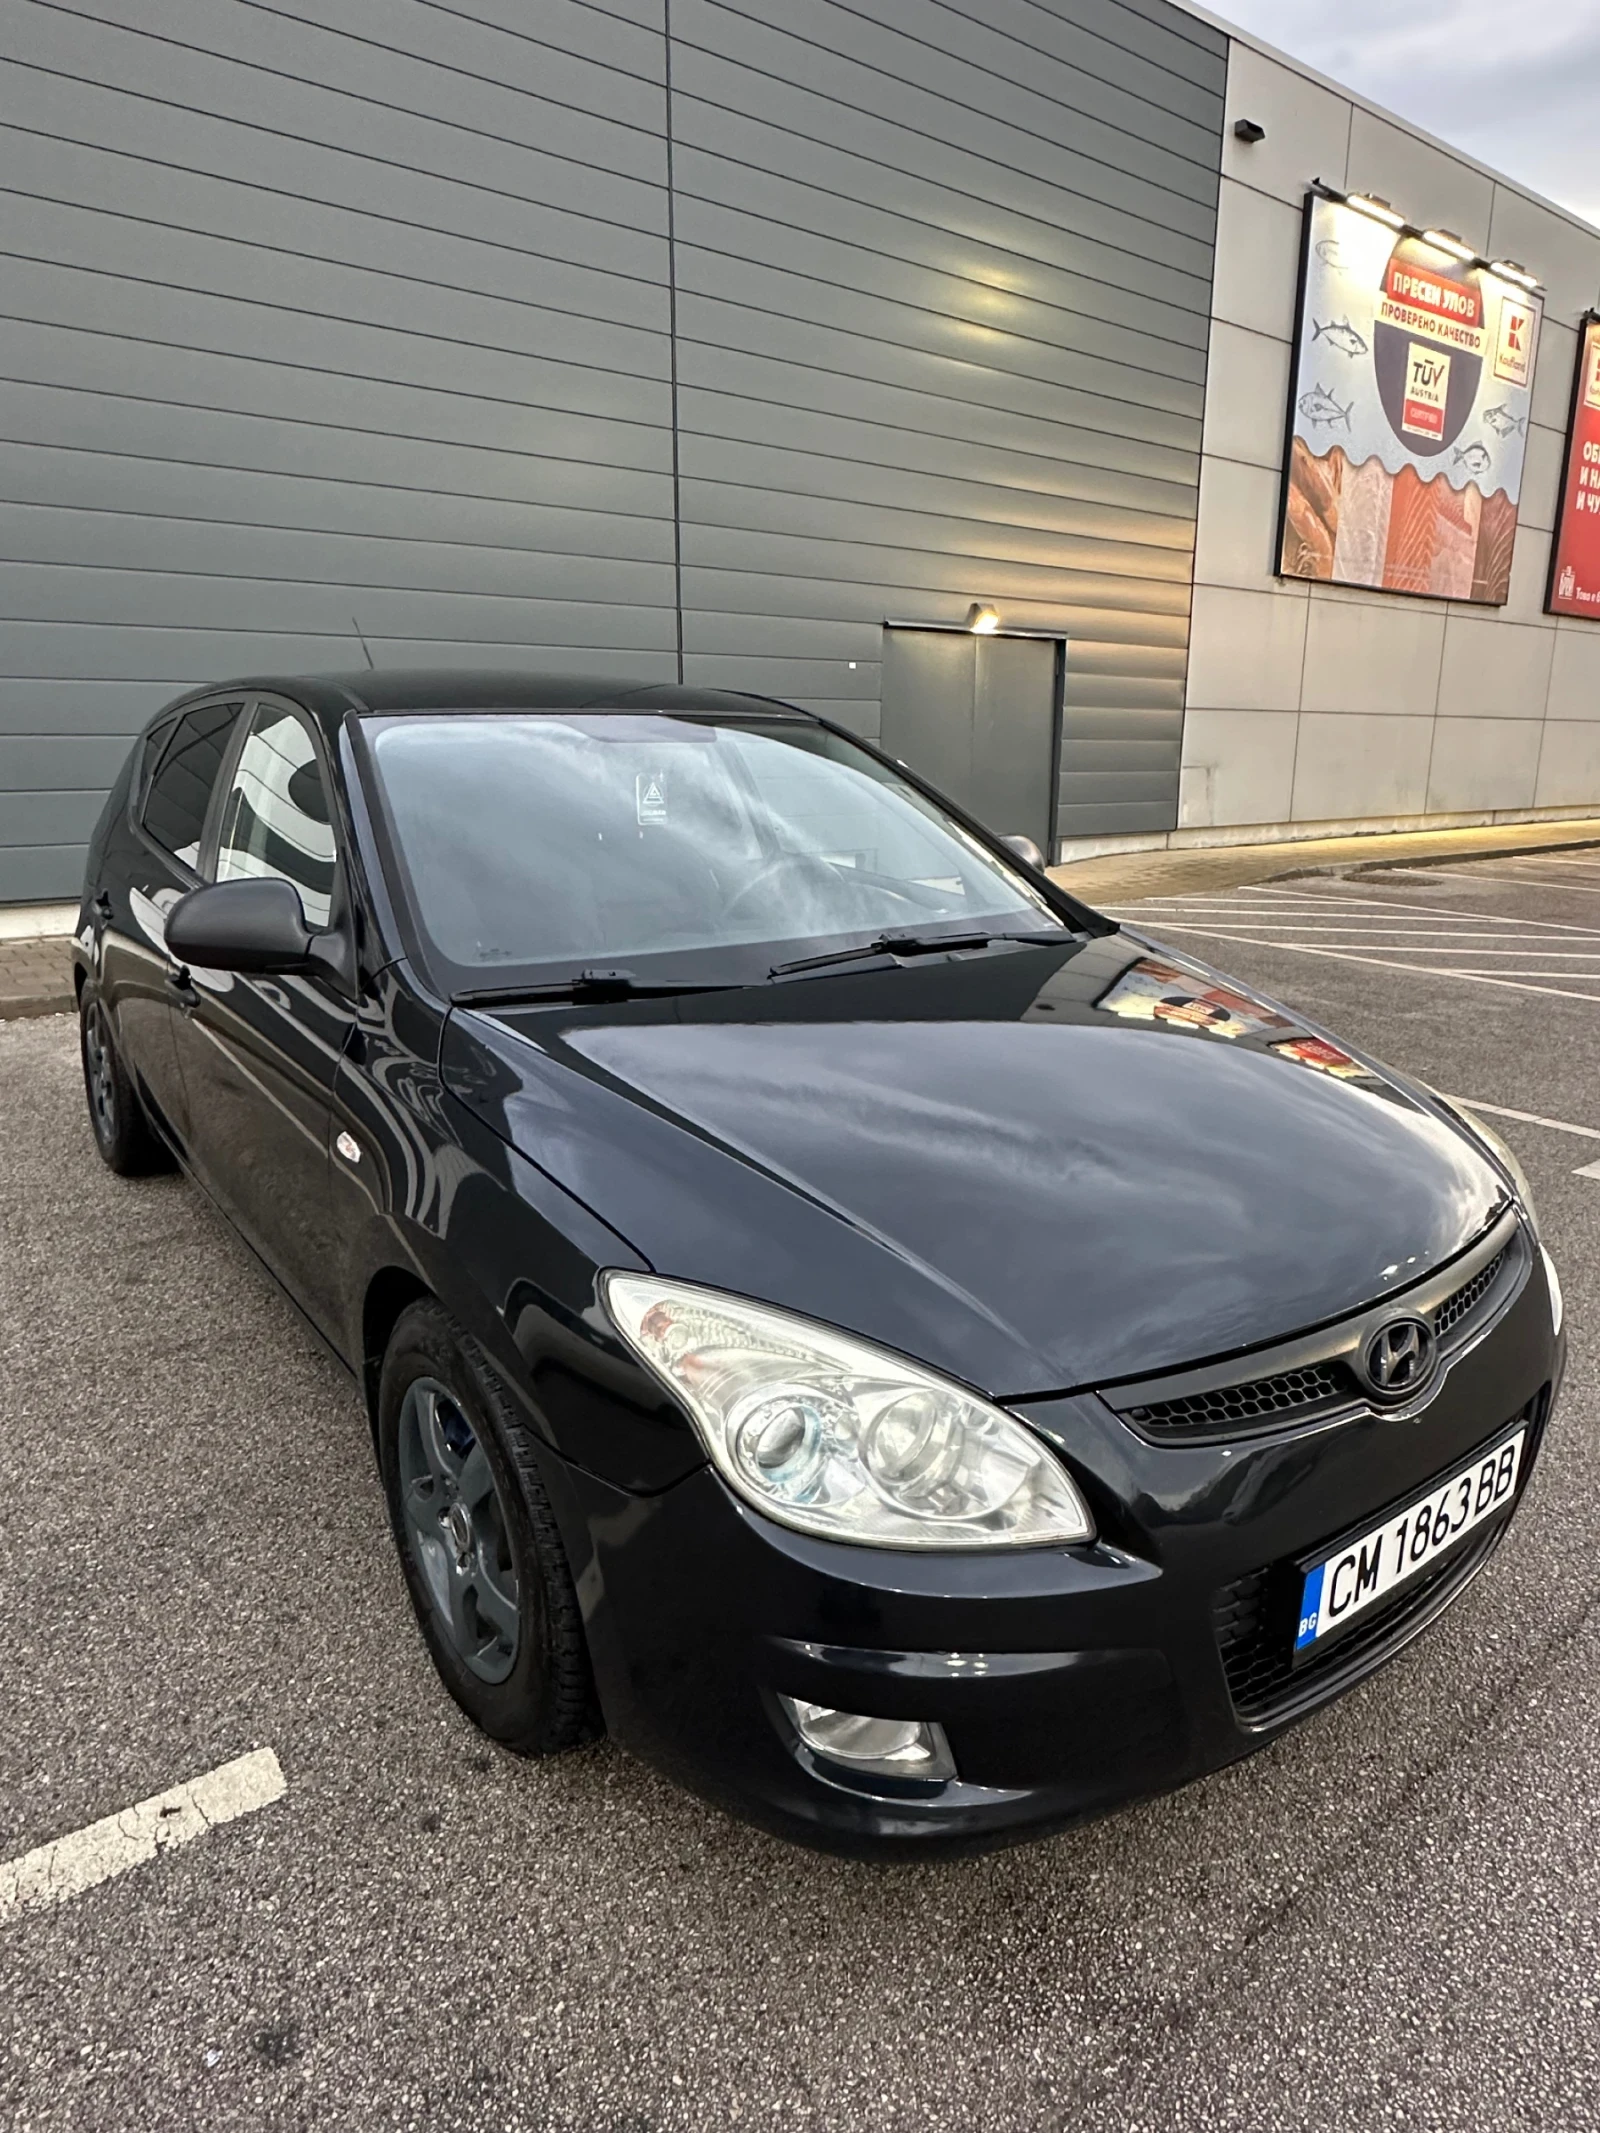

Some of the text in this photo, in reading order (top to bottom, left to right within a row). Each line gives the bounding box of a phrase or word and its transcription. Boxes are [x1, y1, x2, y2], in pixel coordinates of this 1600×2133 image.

[1393, 272, 1475, 318] ПРЕСЕН УЛОВ
[1381, 302, 1481, 349] ПРОВЕРЕНО КАЧЕСТВО
[1410, 386, 1439, 402] AUSTRIA
[1583, 441, 1600, 464] ОБ
[1579, 466, 1589, 486] И
[1576, 490, 1586, 510] И
[1329, 1444, 1515, 1617] CM 1863 BB
[1298, 1612, 1318, 1638] BG
